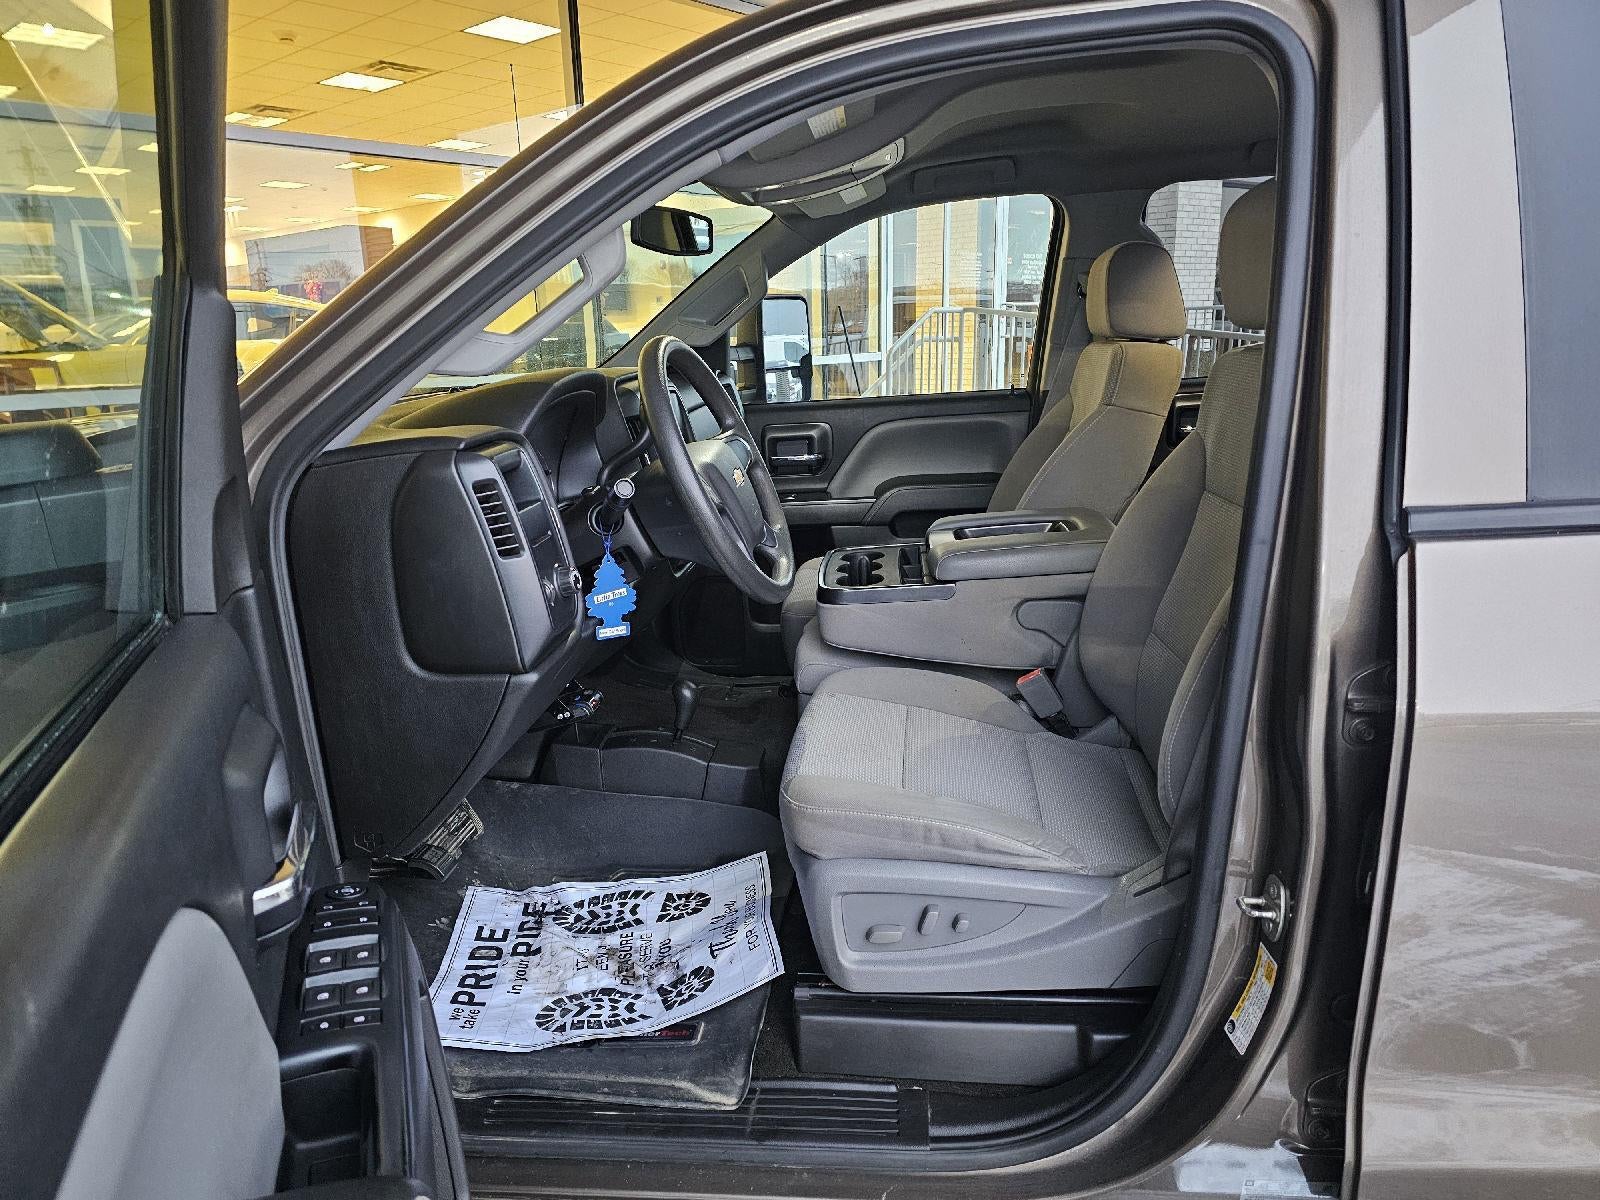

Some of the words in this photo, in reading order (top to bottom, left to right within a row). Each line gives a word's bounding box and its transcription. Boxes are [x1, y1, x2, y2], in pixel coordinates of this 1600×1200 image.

[510, 901, 547, 957] RIDE
[748, 925, 761, 952] FOR
[618, 931, 635, 987] PLEASURE
[656, 937, 672, 963] YOU
[450, 926, 510, 1007] PRIDE
[515, 959, 529, 981] your
[506, 984, 523, 995] in
[448, 1007, 465, 1021] we
[459, 1009, 481, 1030] take
